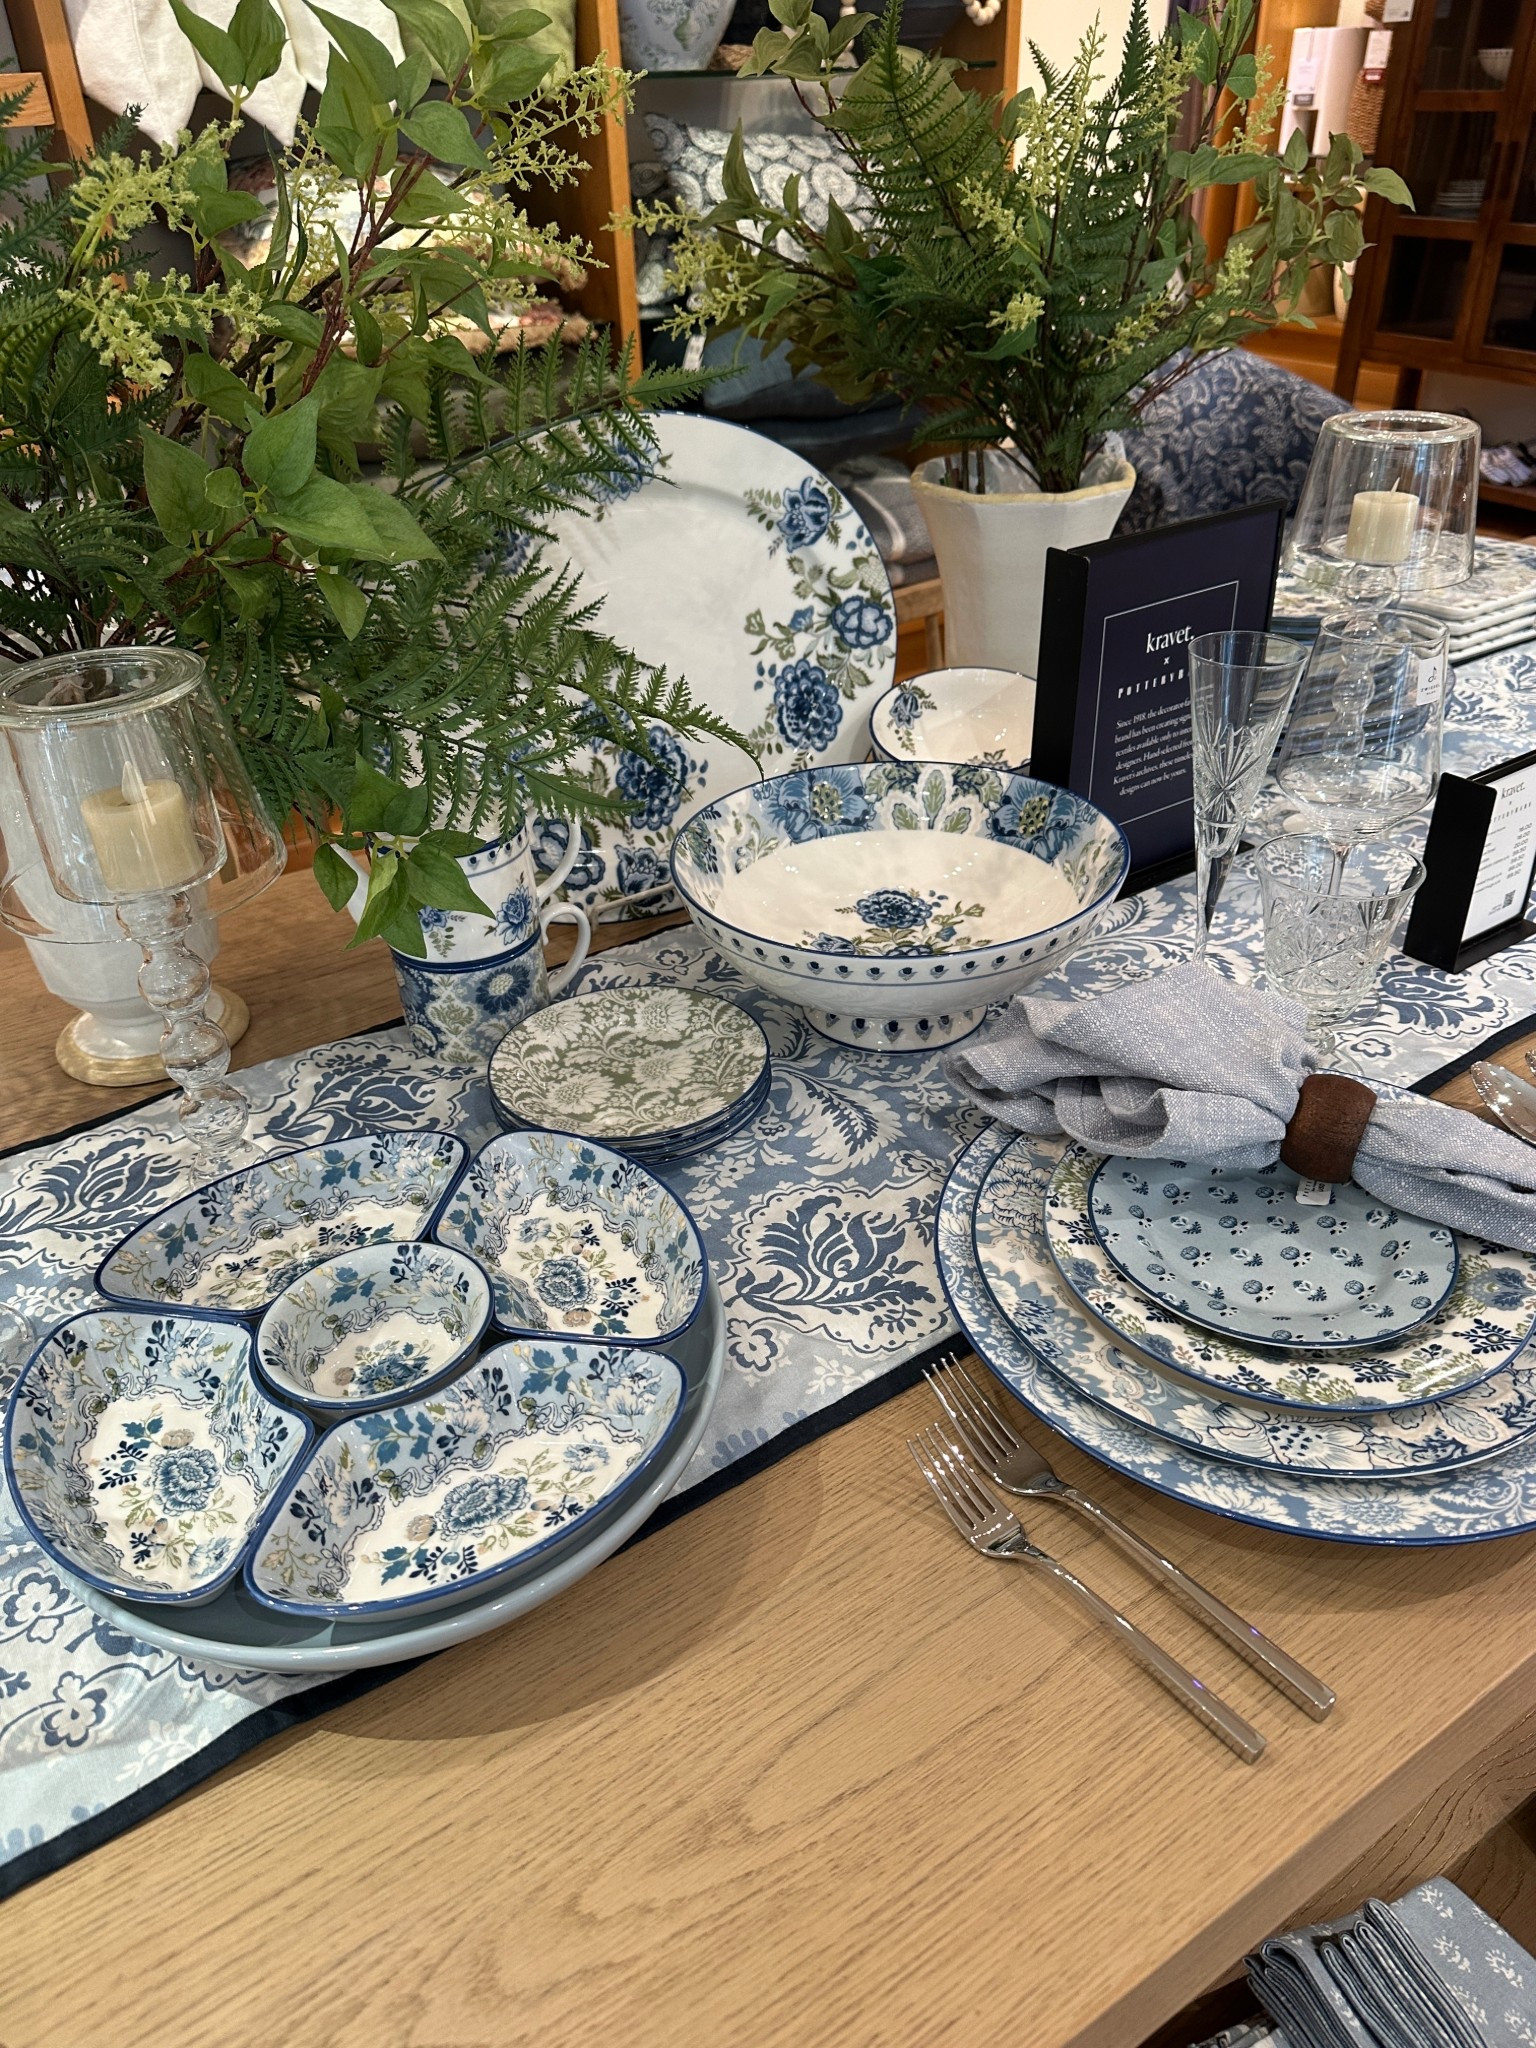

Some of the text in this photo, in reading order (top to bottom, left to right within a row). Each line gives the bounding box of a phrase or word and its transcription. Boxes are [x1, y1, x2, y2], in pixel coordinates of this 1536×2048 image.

[1146, 625, 1196, 654] kravet.
[1118, 668, 1190, 699] POTTERYB
[1114, 730, 1132, 744] brand
[1142, 725, 1156, 735] been
